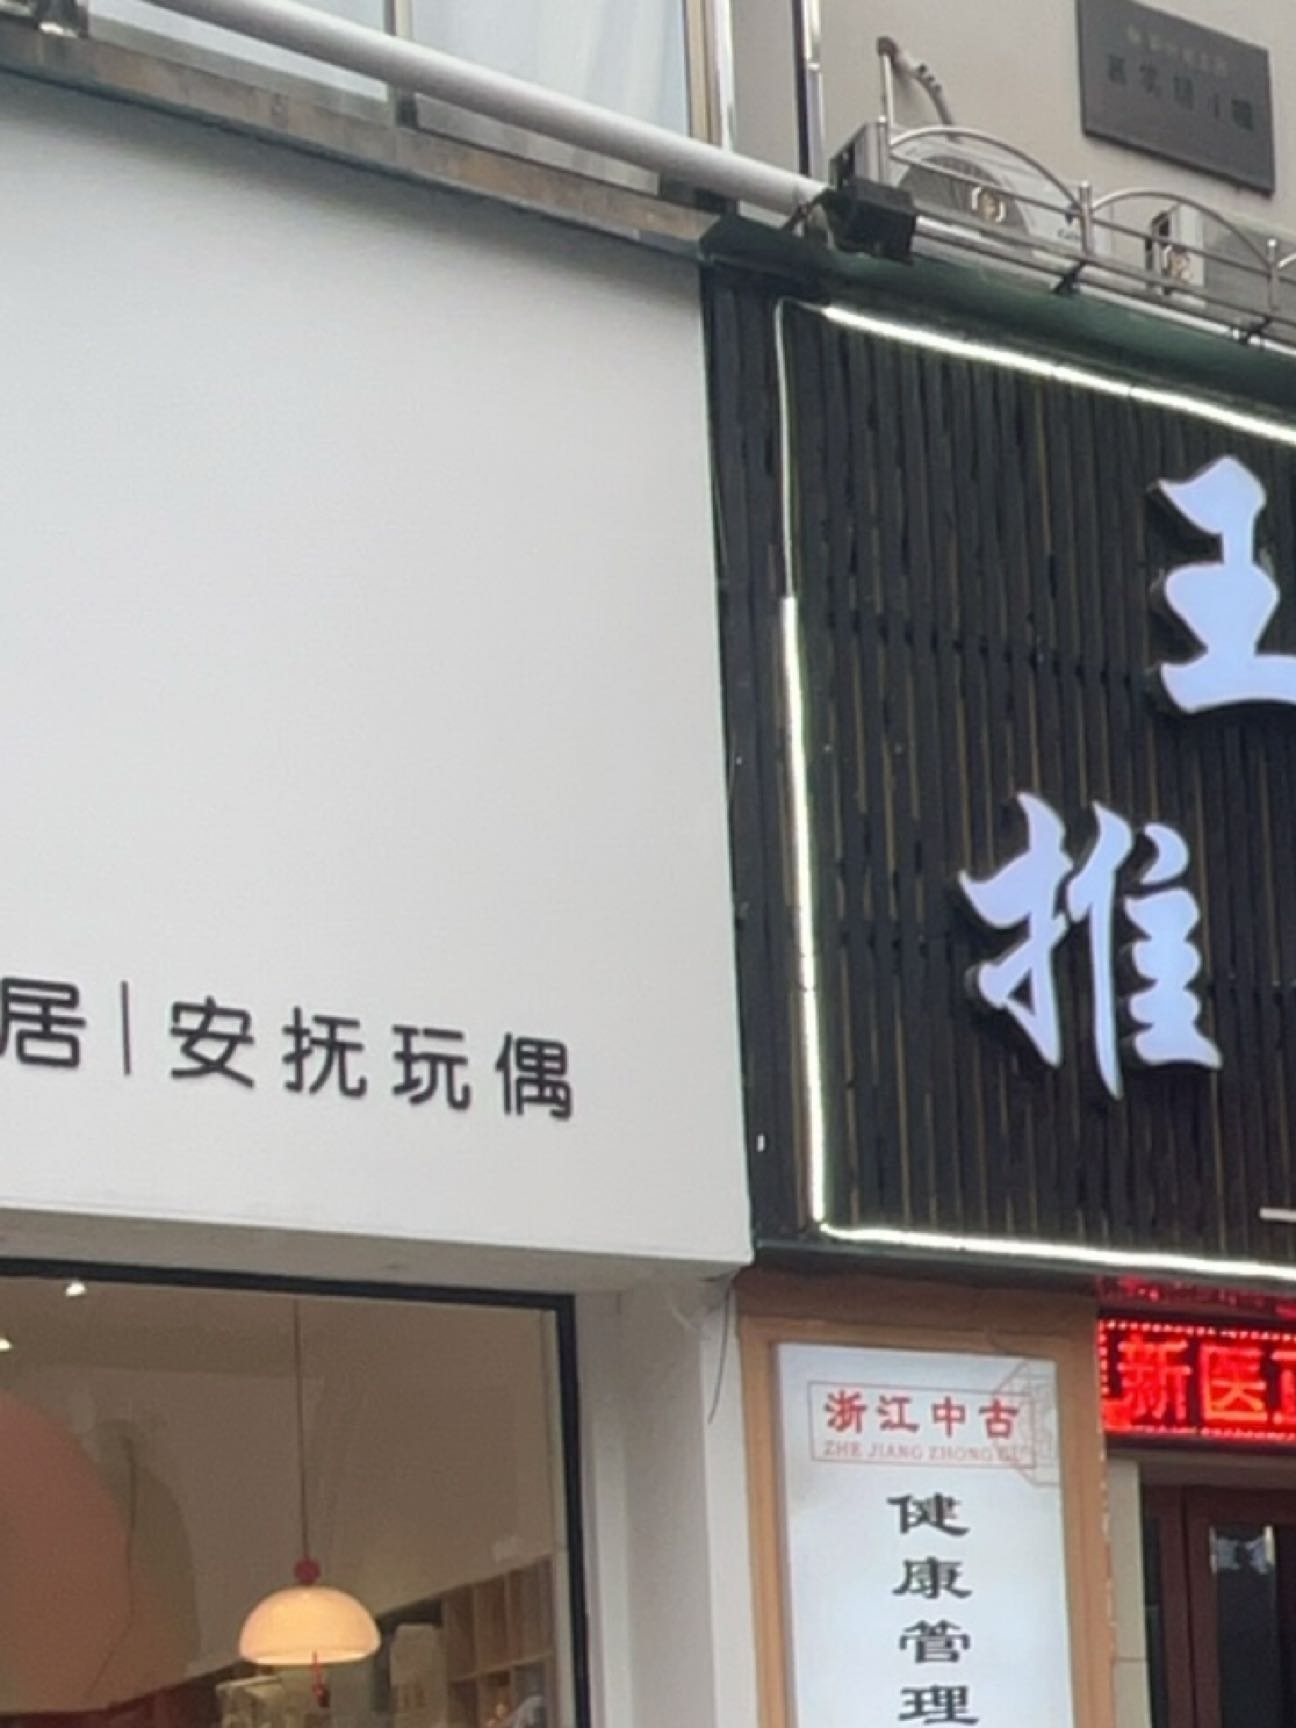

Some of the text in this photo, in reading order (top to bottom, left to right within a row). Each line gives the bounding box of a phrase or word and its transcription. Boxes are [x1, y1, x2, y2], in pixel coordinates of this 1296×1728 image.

[0, 977, 573, 1120] 居 安抚玩偶
[823, 1389, 1020, 1440] 浙江中古
